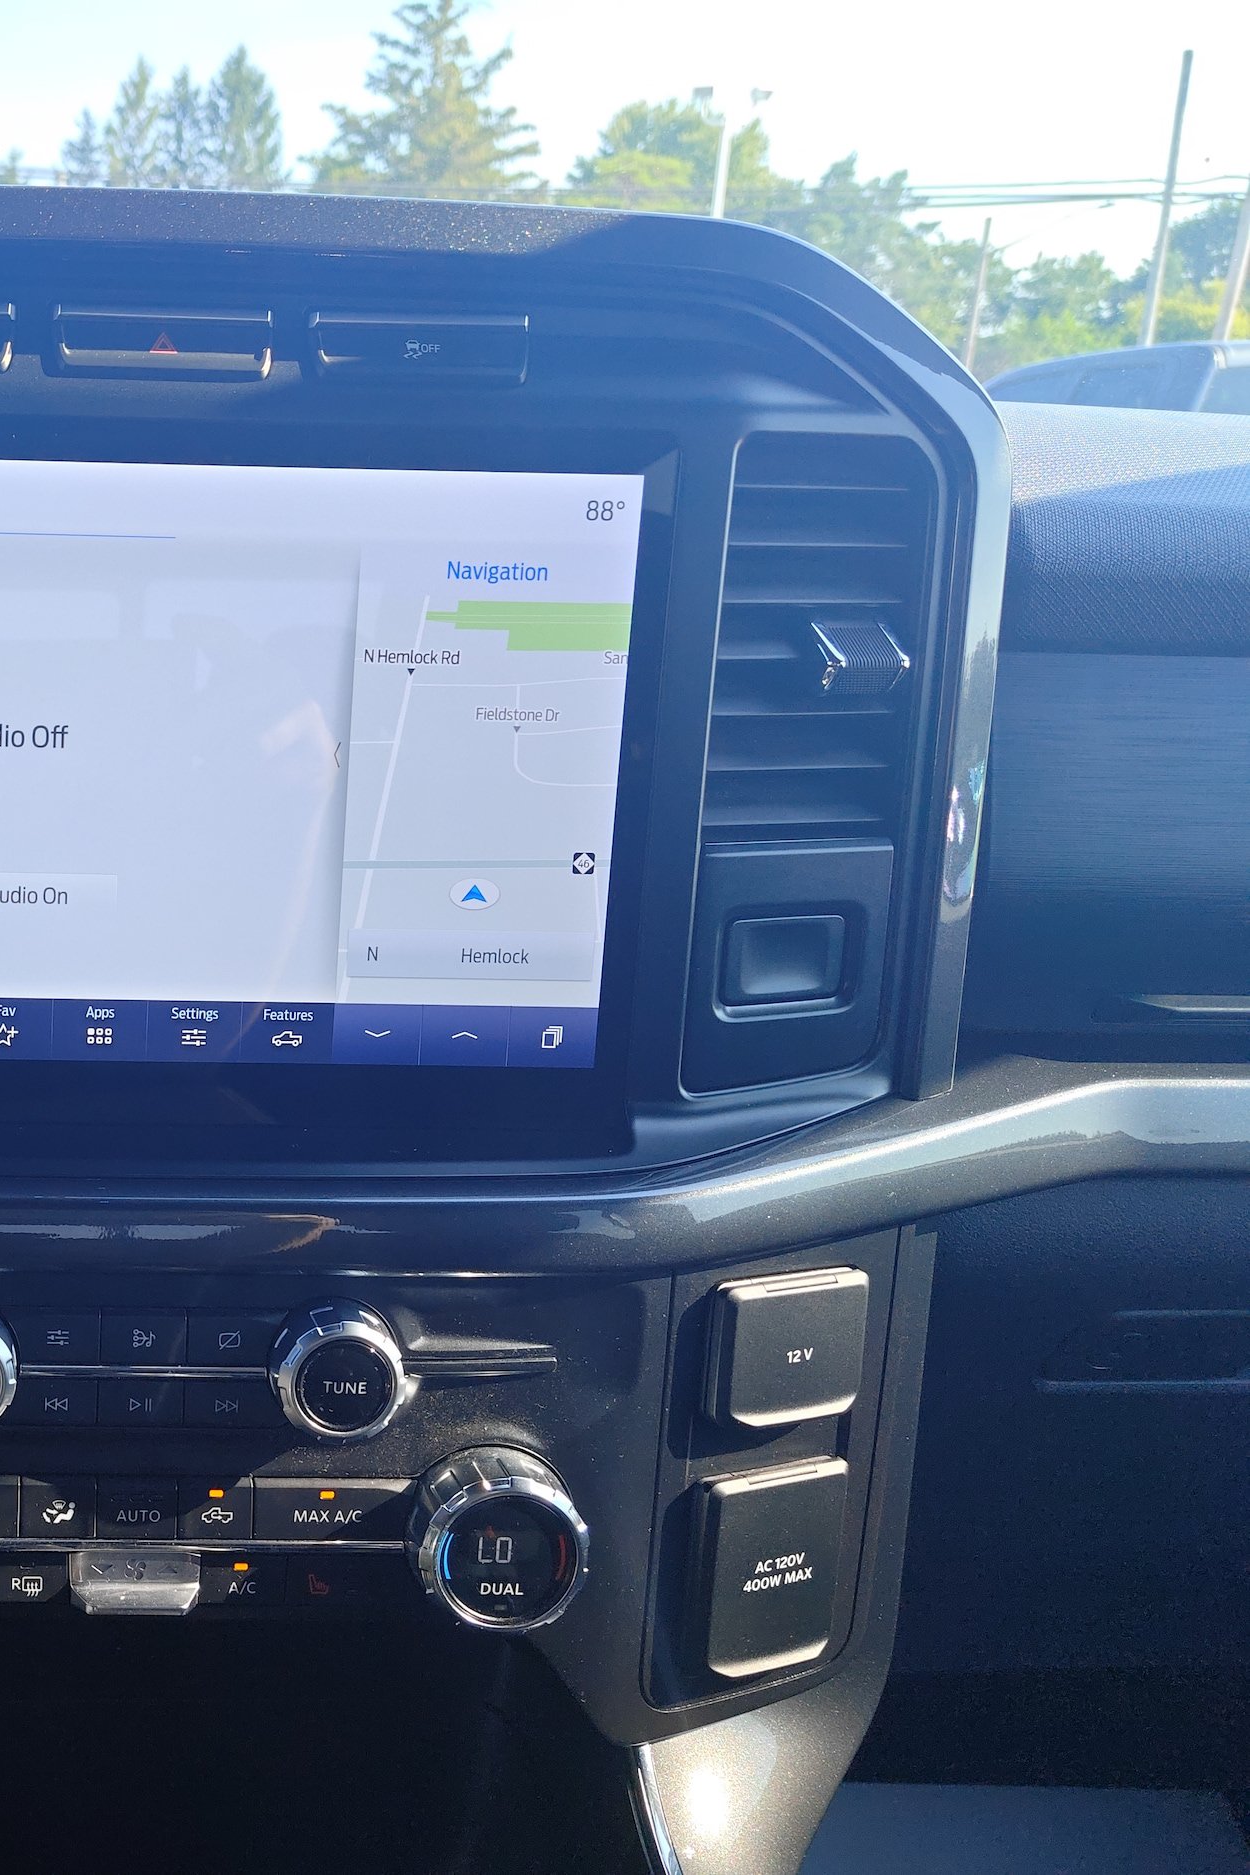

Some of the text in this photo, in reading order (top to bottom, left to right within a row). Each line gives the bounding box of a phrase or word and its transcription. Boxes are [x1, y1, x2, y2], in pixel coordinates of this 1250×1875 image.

[421, 343, 440, 353] OFF
[586, 500, 626, 521] 88°
[447, 561, 549, 584] Navigation
[364, 650, 460, 664] N Hemlock Rd
[475, 708, 560, 721] Fieldstone Dr
[31, 725, 68, 749] Off
[578, 859, 590, 869] 46
[41, 887, 68, 905] On
[367, 946, 378, 961] N
[461, 948, 529, 964] Hemlock
[86, 1006, 115, 1020] Apps
[171, 1007, 219, 1022] Settings
[263, 1009, 314, 1022] Features
[786, 1347, 814, 1364] 12 V
[324, 1381, 368, 1395] TUNE
[116, 1509, 161, 1522] AUTO
[293, 1509, 362, 1524] MAX A/C
[754, 1552, 805, 1574] AC 120V
[11, 1577, 21, 1591] R
[742, 1566, 812, 1592] 400W MAX
[228, 1581, 256, 1594] A/C
[479, 1582, 523, 1596] DUAL
